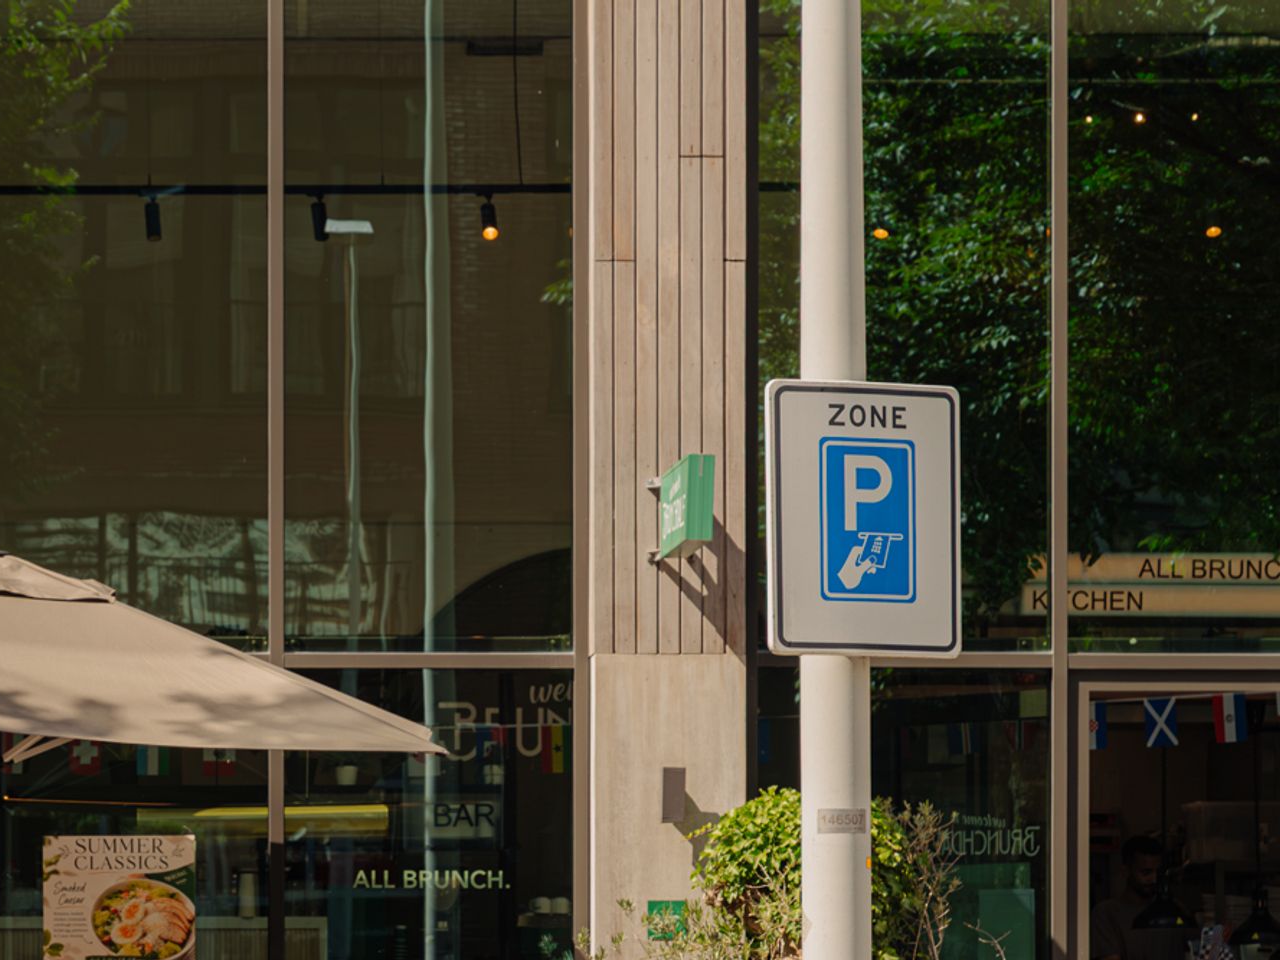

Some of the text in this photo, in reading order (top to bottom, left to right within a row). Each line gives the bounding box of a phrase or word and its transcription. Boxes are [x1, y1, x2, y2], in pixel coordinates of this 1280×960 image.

[828, 403, 907, 429] ZONE
[843, 454, 892, 532] P
[1138, 558, 1280, 579] ALL BRUNC
[1032, 590, 1144, 611] KCHEN
[434, 803, 495, 828] BAR
[74, 838, 164, 854] SUMMER
[74, 855, 169, 871] CLASSICS
[53, 881, 87, 896] Smoked
[353, 870, 511, 889] ALL BRUNCH.
